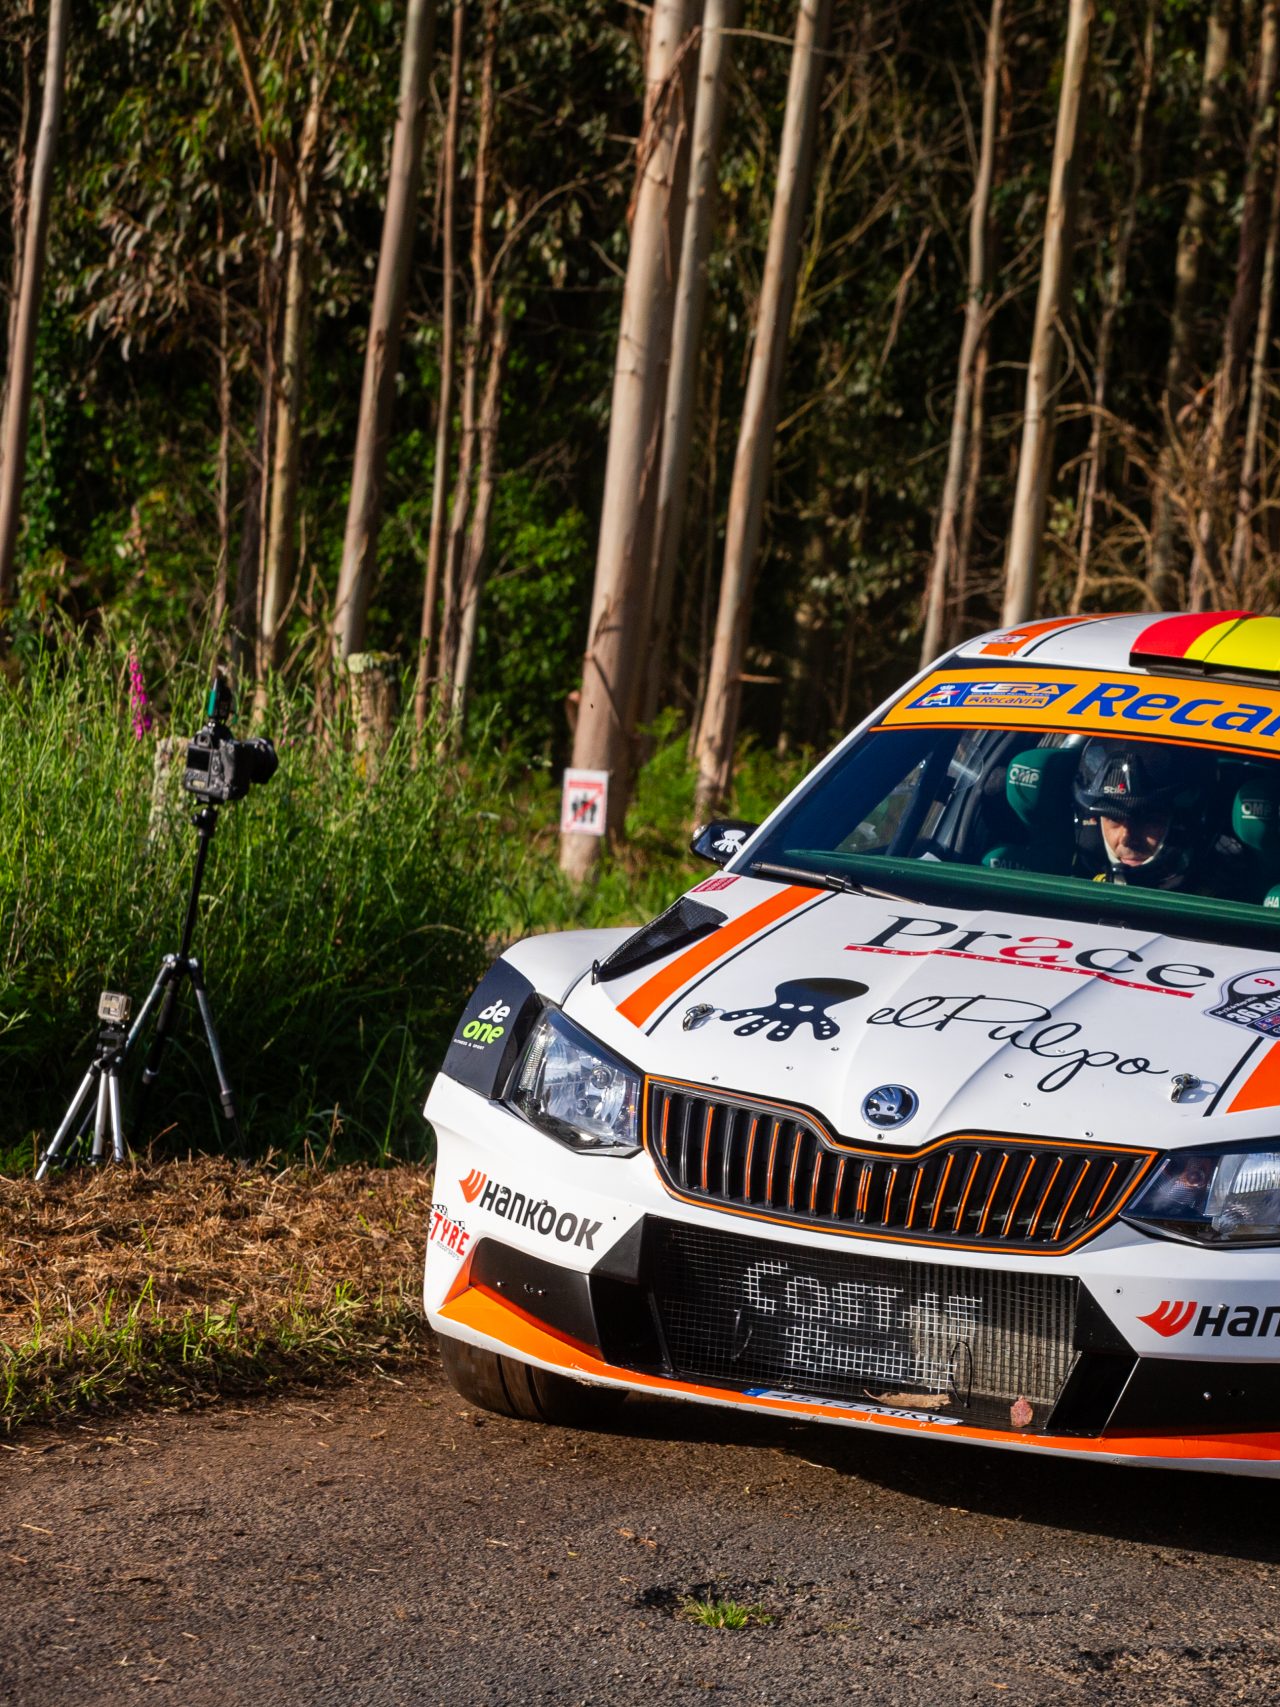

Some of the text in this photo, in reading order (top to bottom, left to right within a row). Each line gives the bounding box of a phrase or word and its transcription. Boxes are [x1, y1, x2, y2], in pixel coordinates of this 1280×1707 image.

[970, 683, 1060, 695] CERA
[980, 696, 1032, 706] Recalvi
[1009, 767, 1040, 784] OMP
[1103, 783, 1127, 795] Stilo
[850, 914, 1216, 989] Prace
[1254, 978, 1276, 987] 9
[1226, 1008, 1257, 1024] 36
[462, 1020, 505, 1044] one
[935, 995, 1170, 1092] Pulpo
[479, 1180, 604, 1251] HANKOOK
[430, 1211, 471, 1256] TYRE
